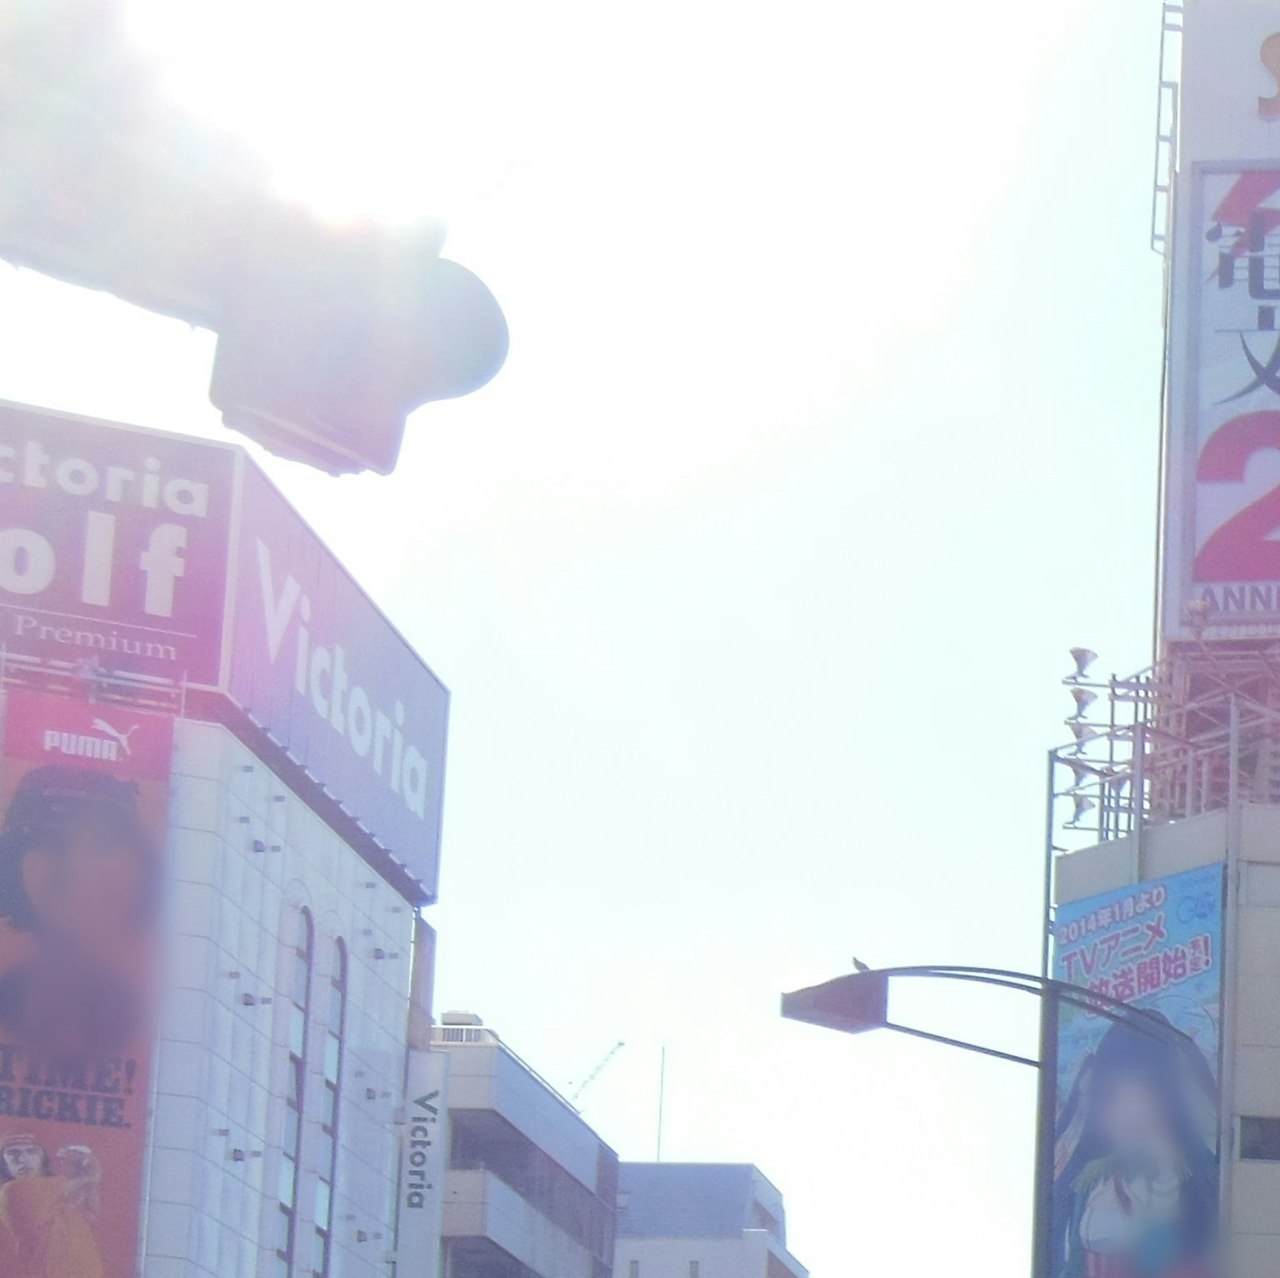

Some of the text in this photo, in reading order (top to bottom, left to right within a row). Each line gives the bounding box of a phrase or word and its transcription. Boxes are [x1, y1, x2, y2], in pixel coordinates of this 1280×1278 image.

[15, 613, 178, 662] Premium
[255, 535, 429, 820] Victoria
[44, 730, 118, 761] PUMA
[1058, 886, 1167, 946] 2014年1月より
[1061, 912, 1168, 984] TVアニメ
[406, 1089, 440, 1210] Victoria
